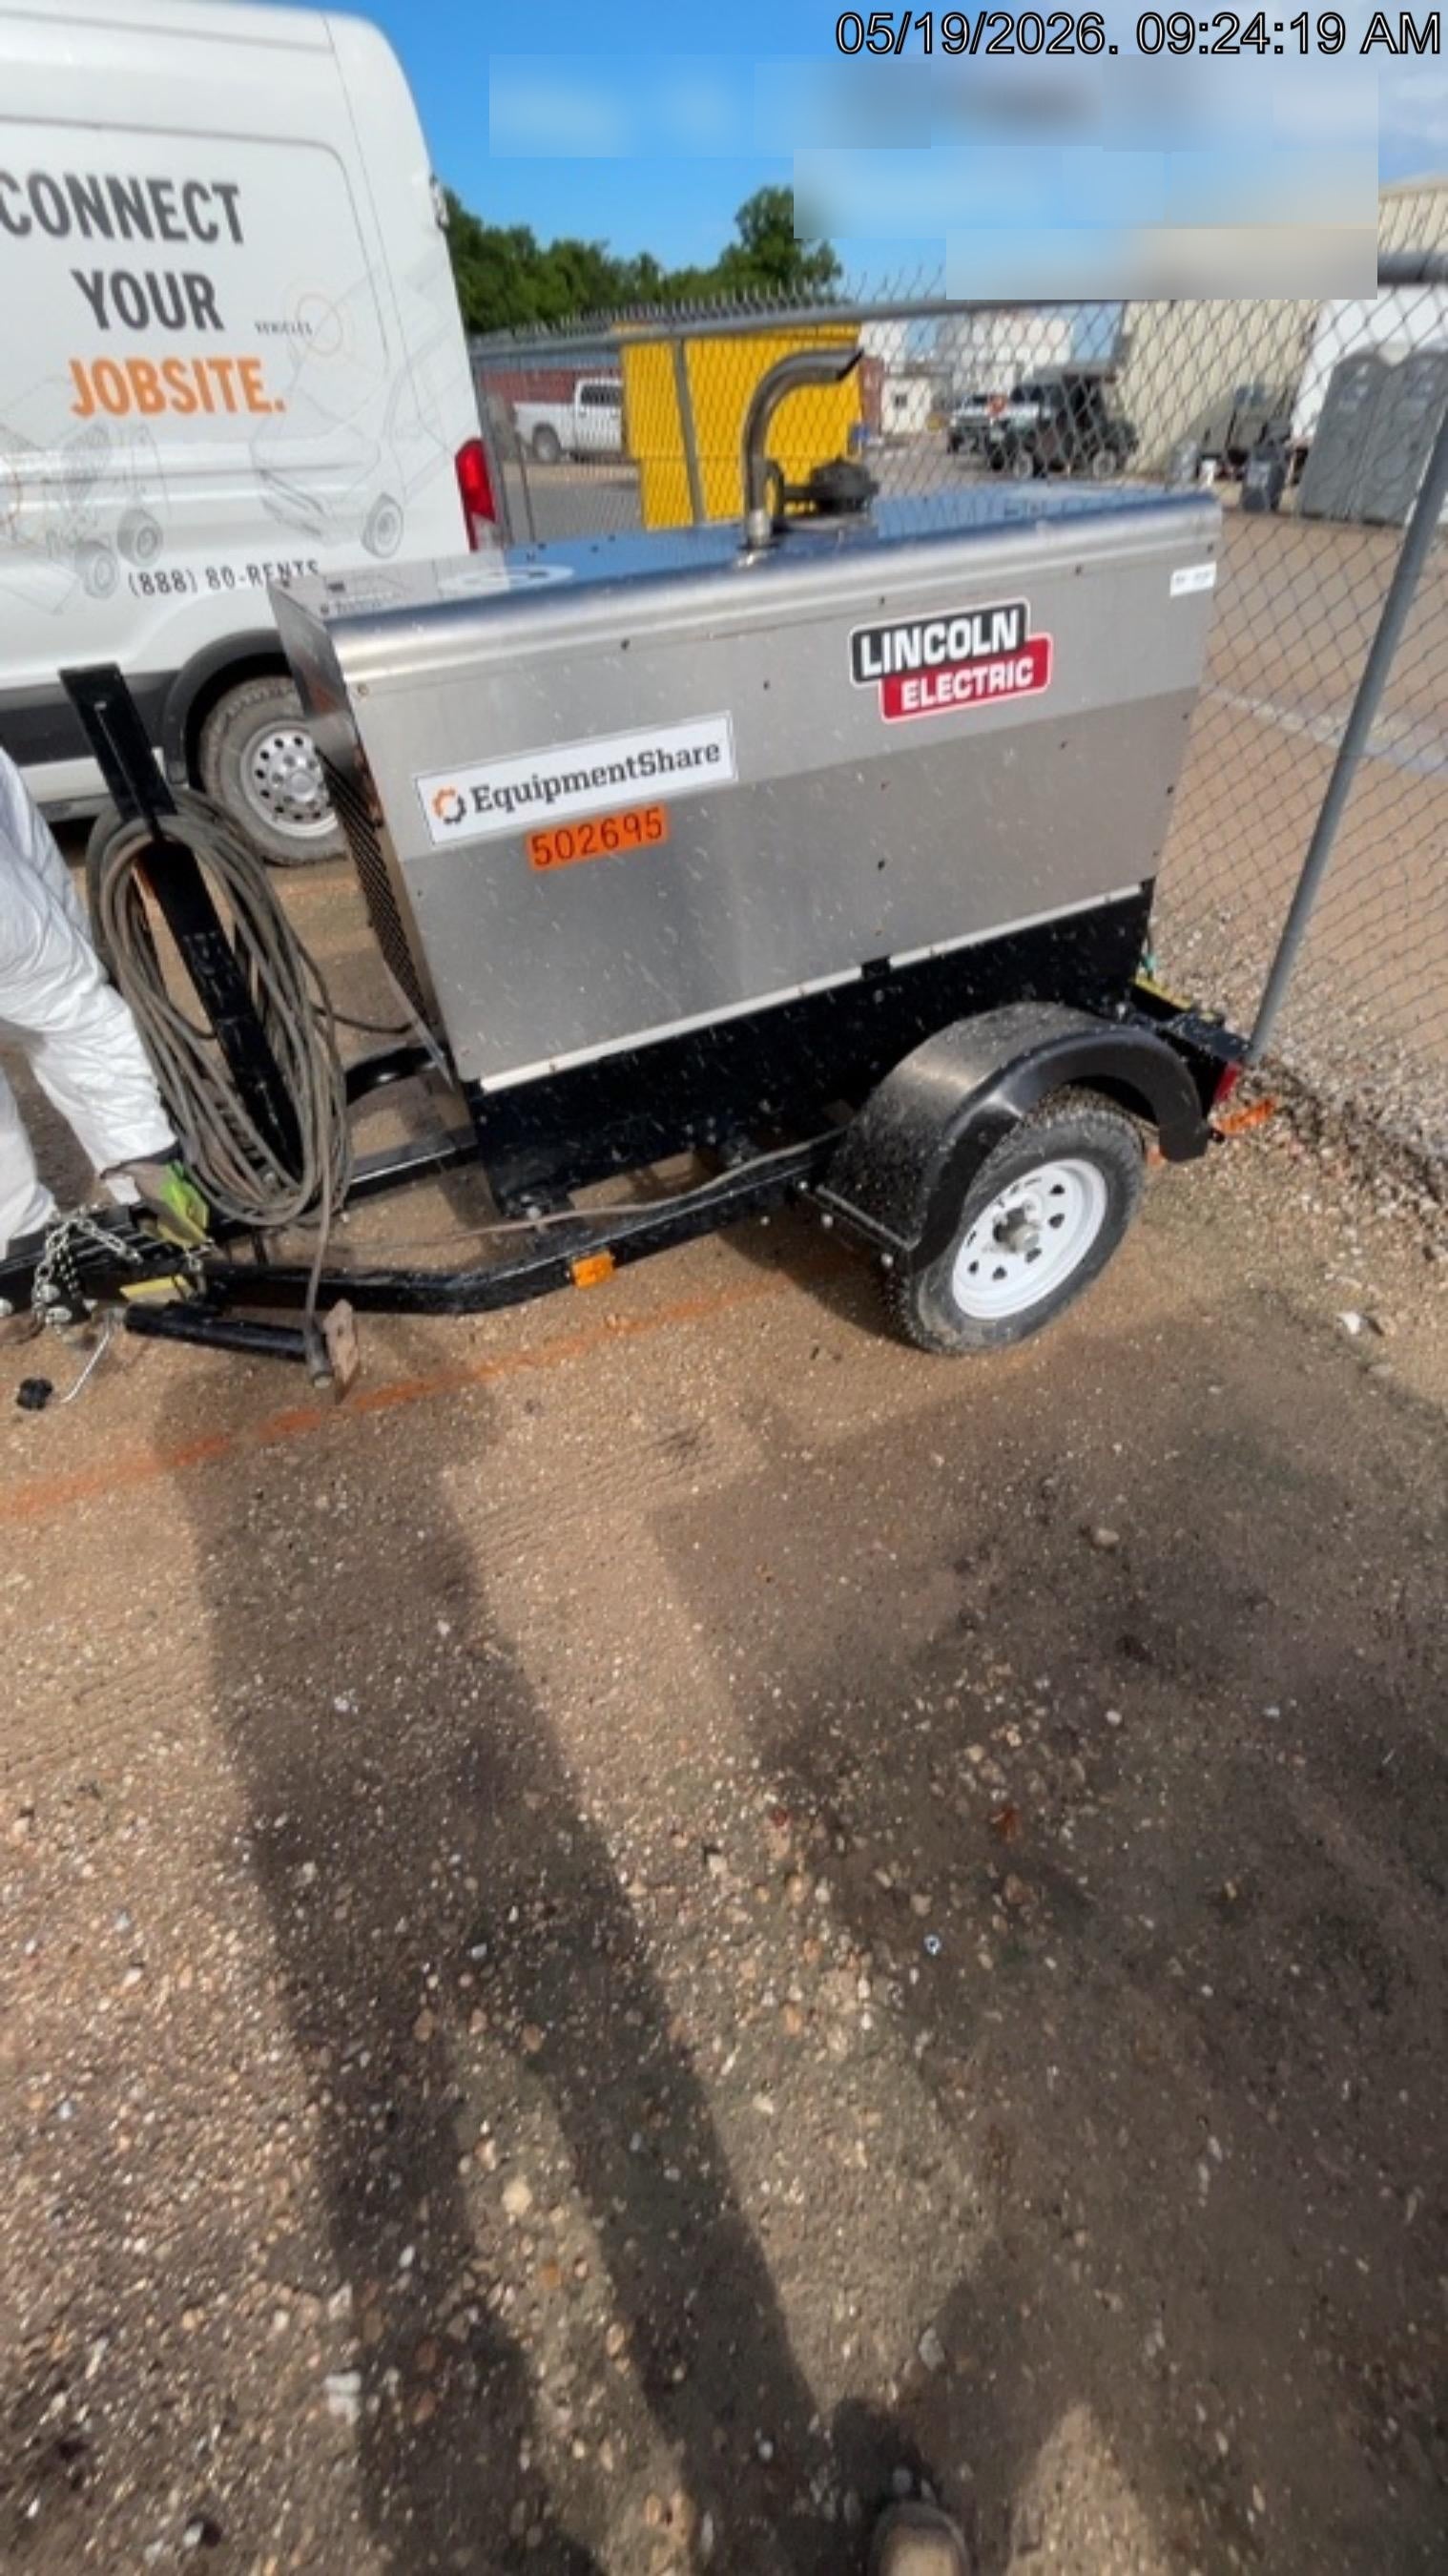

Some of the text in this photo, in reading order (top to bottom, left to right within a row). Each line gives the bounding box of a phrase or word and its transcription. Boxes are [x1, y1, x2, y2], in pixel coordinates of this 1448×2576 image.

[0, 171, 243, 245] CONNECT
[71, 269, 225, 331] YOUR
[69, 357, 285, 418] JOBSITE.
[129, 568, 197, 598] (888)
[860, 609, 1020, 677] LINCOLN
[901, 657, 1034, 711] ELECTRIC
[470, 742, 720, 813] EquipmentShare
[531, 806, 663, 866] 502695
